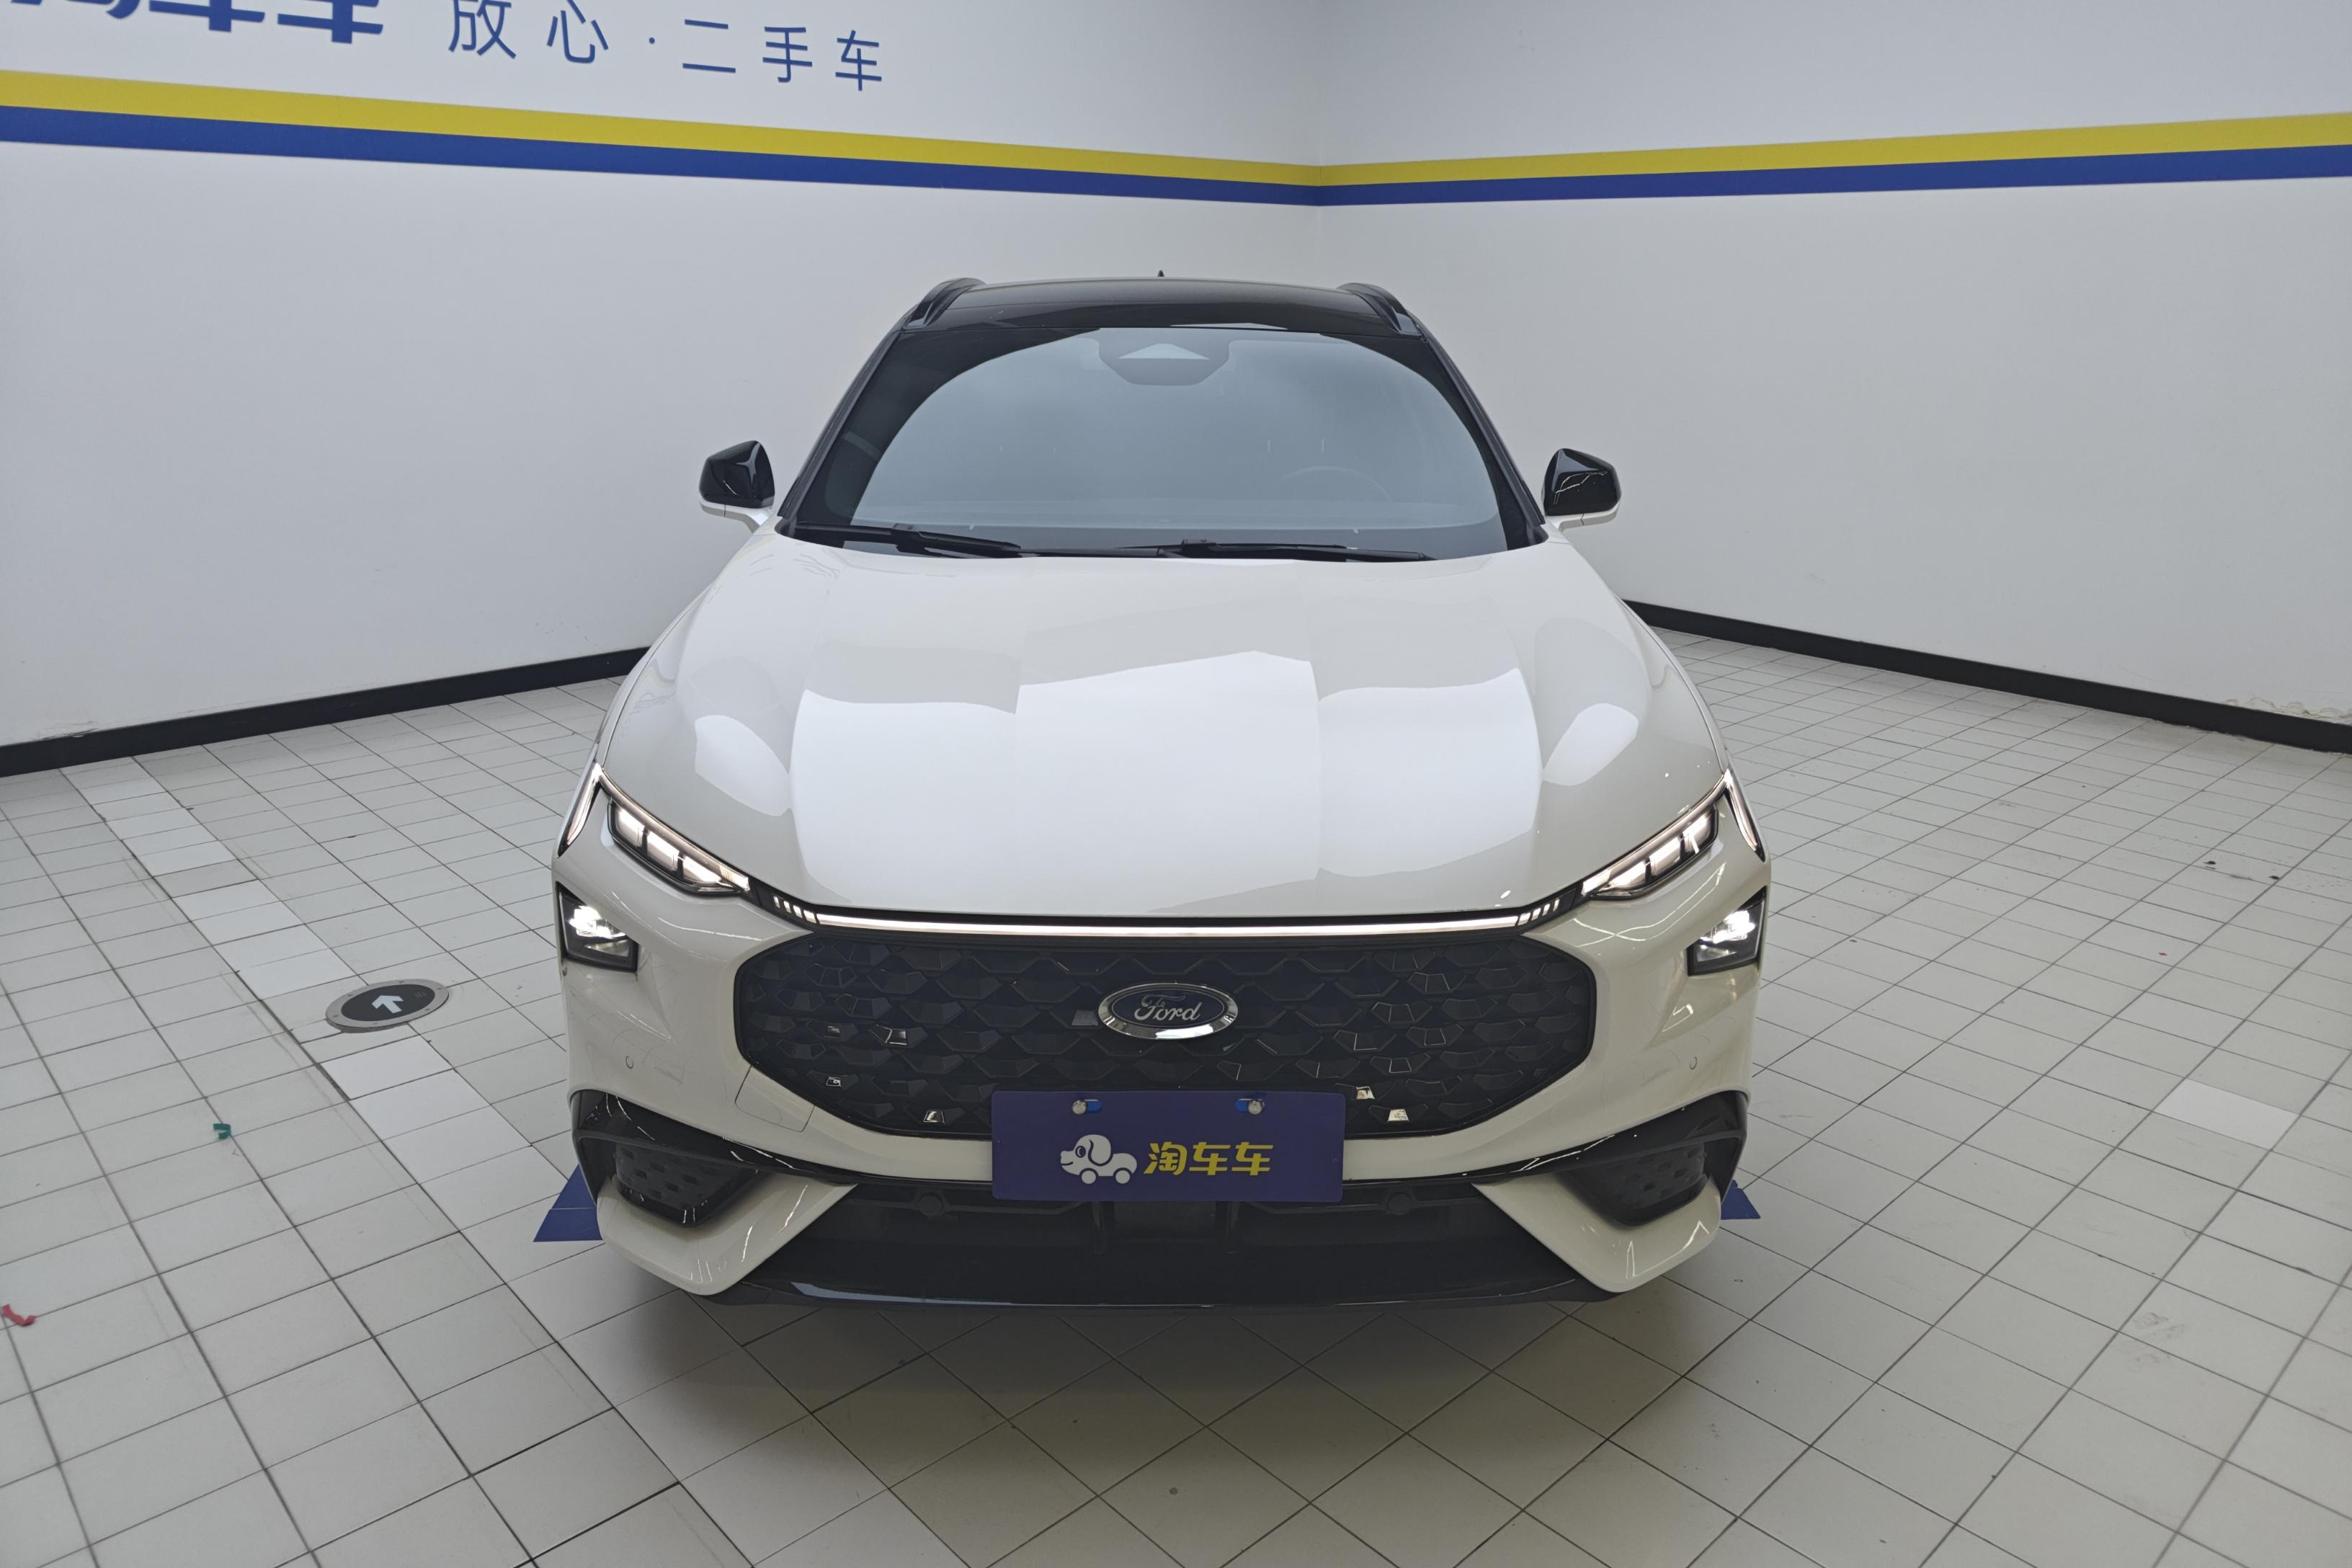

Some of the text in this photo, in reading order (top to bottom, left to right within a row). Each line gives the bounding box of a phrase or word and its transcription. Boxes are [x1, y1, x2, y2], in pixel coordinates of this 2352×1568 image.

[1134, 994, 1203, 1021] Ford
[1144, 1141, 1273, 1176] 淘车车
